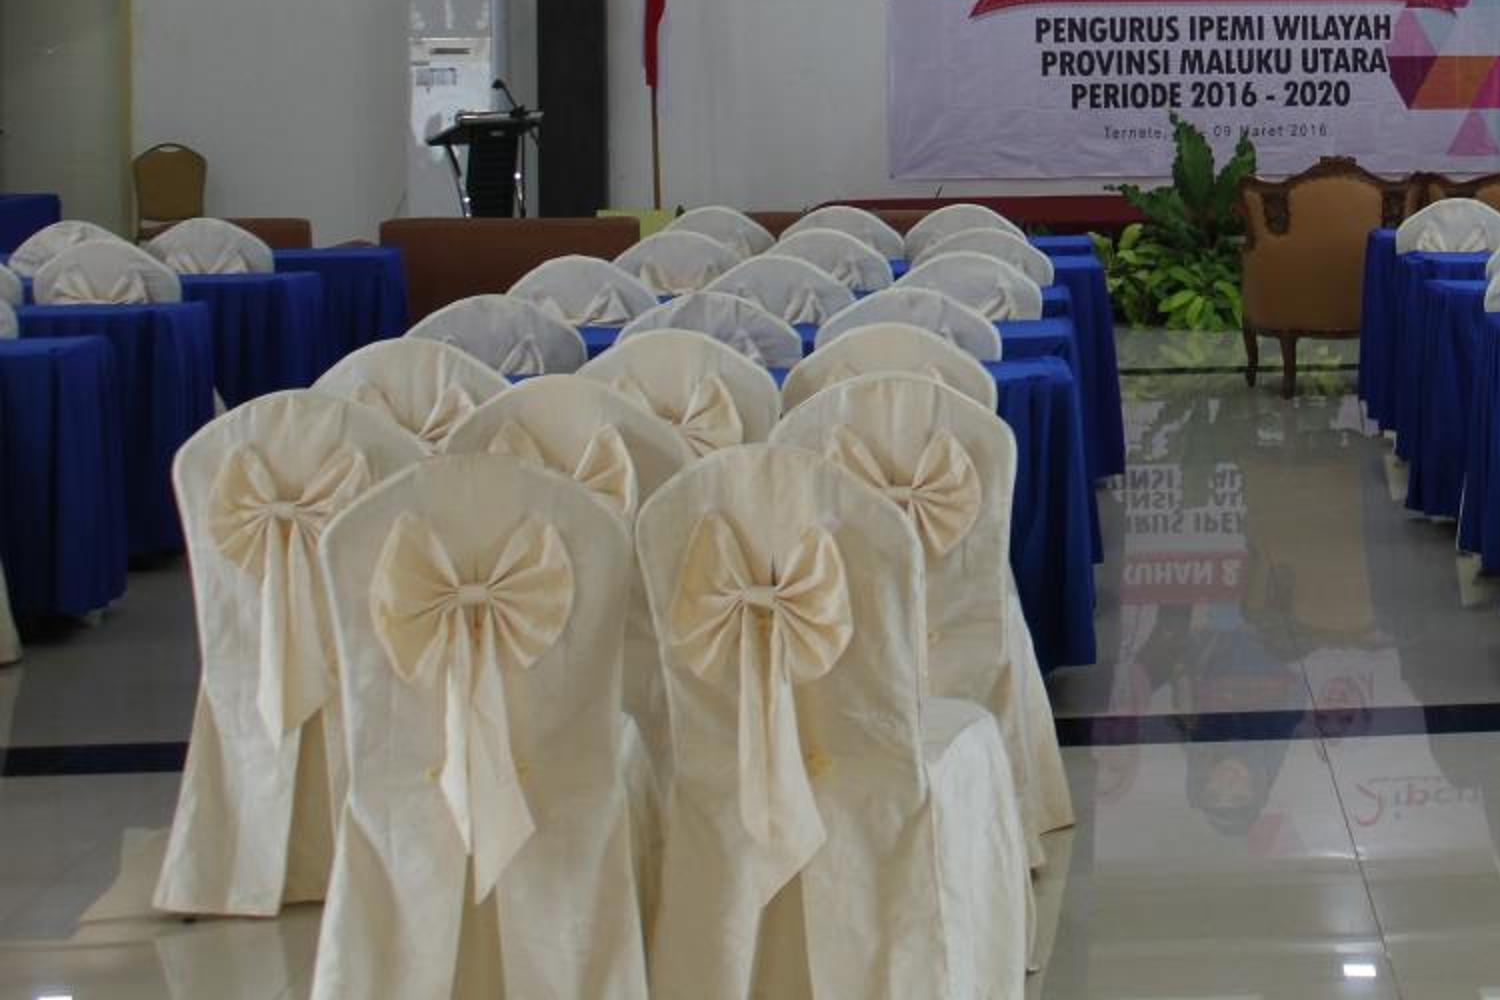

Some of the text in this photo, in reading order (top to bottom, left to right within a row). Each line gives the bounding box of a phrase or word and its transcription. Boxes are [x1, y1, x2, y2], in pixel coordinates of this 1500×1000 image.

[1035, 14, 1392, 44] PENGURUS IPEMI WILAYAH
[1041, 47, 1388, 77] PROVINSI MALUKU UTARA
[1071, 82, 1181, 110] PERIODE
[1191, 81, 1257, 108] 2016
[1284, 81, 1351, 107] 2020
[1213, 125, 1231, 137] 09
[1290, 123, 1327, 137] 2016
